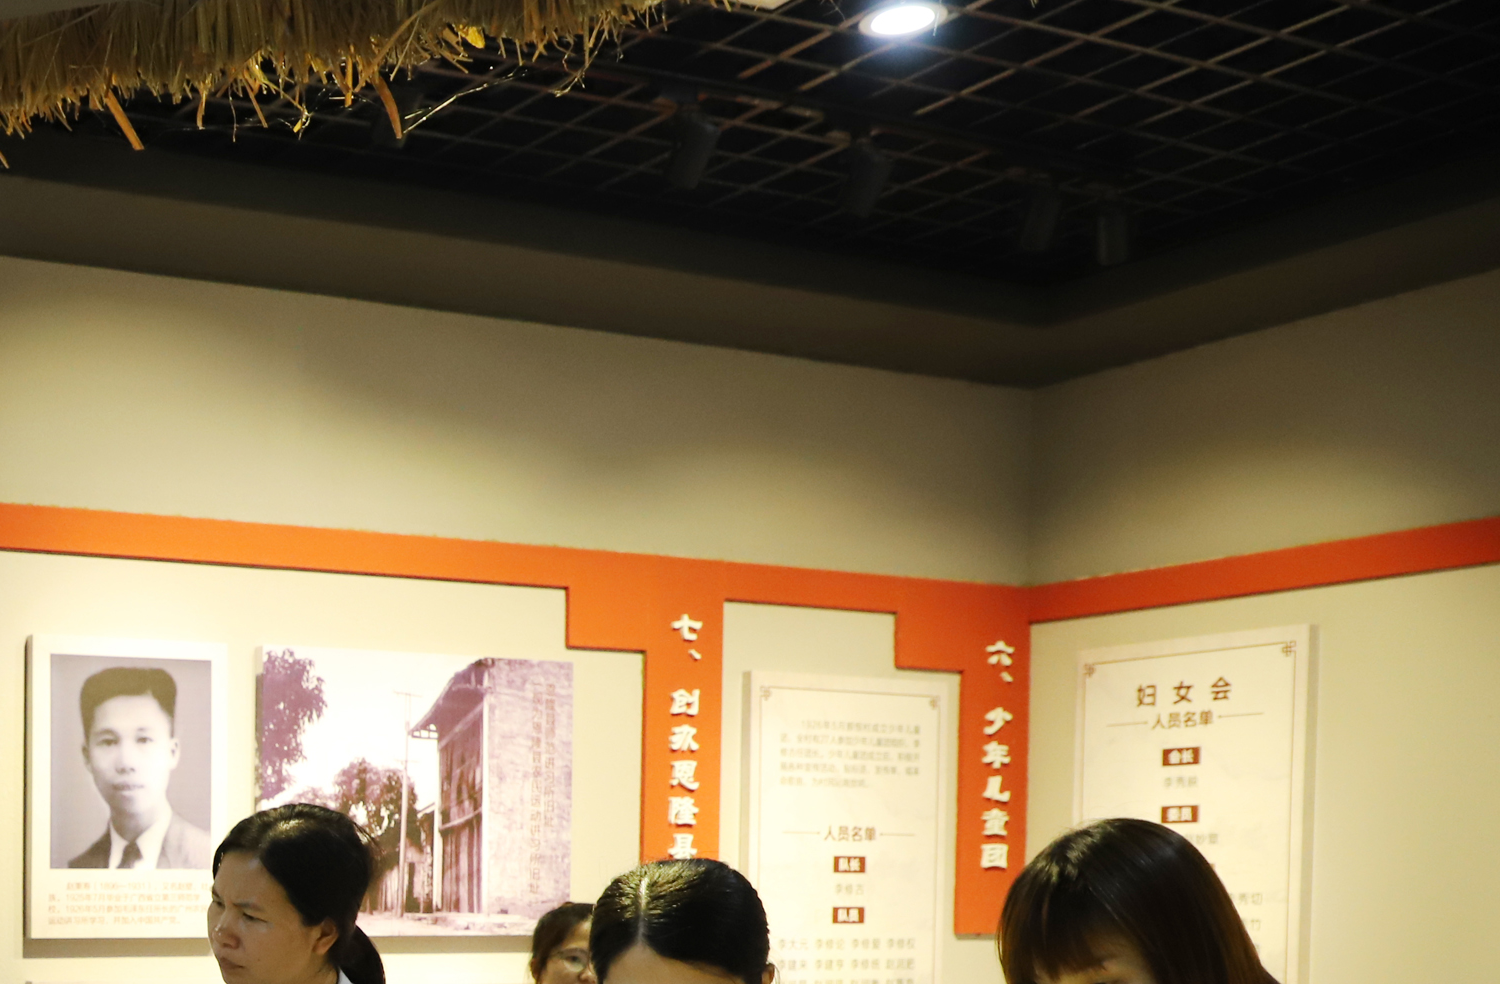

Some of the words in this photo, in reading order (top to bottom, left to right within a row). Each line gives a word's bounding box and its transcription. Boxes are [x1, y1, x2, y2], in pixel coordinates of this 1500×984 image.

[1135, 676, 1234, 708] 妇女会
[1151, 709, 1214, 729] 人员名单
[980, 640, 1015, 869] 六、少年儿童团
[1168, 749, 1194, 764] 会长
[824, 826, 876, 842] 人员名单
[838, 857, 861, 872] 队长
[837, 908, 859, 923] 队员
